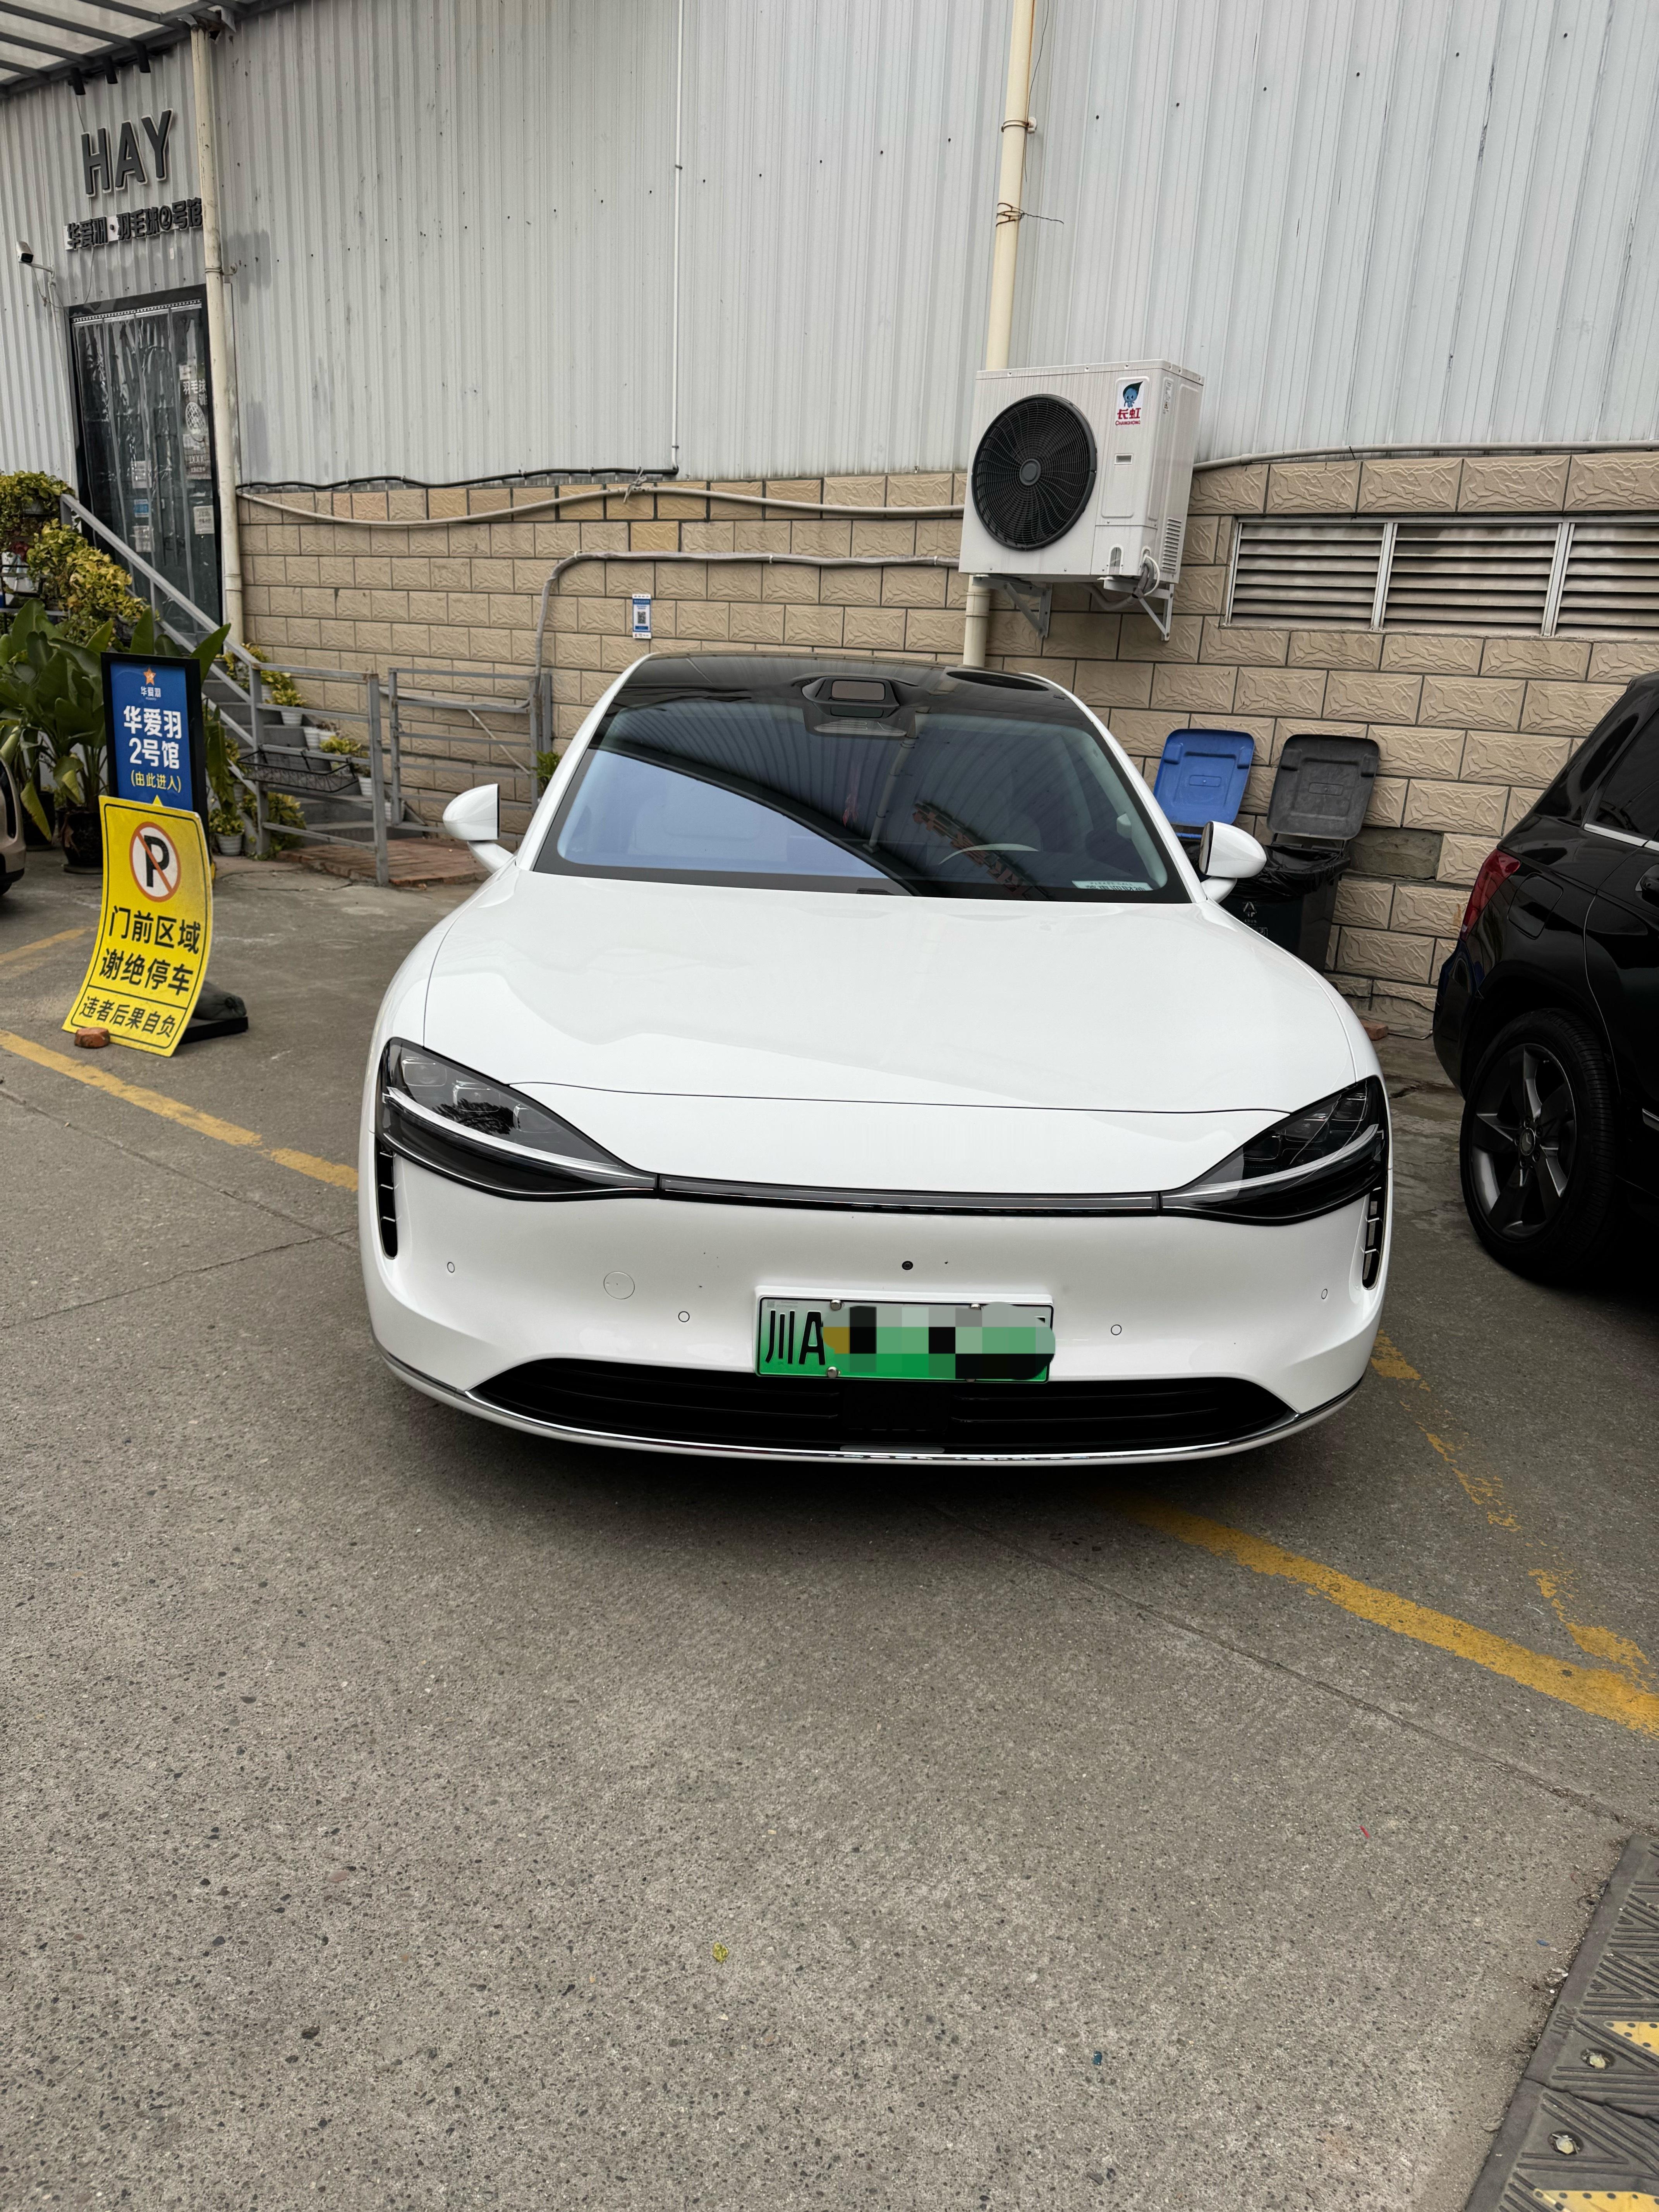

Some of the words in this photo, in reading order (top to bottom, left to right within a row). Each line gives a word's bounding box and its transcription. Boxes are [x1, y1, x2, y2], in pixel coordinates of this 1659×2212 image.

[81, 109, 173, 195] HAY
[1117, 408, 1141, 419] 长虹
[141, 686, 161, 697] 华爱羽
[124, 705, 182, 738] 华爱羽
[129, 738, 180, 769] 2号馆
[108, 905, 201, 954] 门前区域
[99, 948, 194, 996] 谢绝停车
[79, 996, 177, 1039] 违者后果自负
